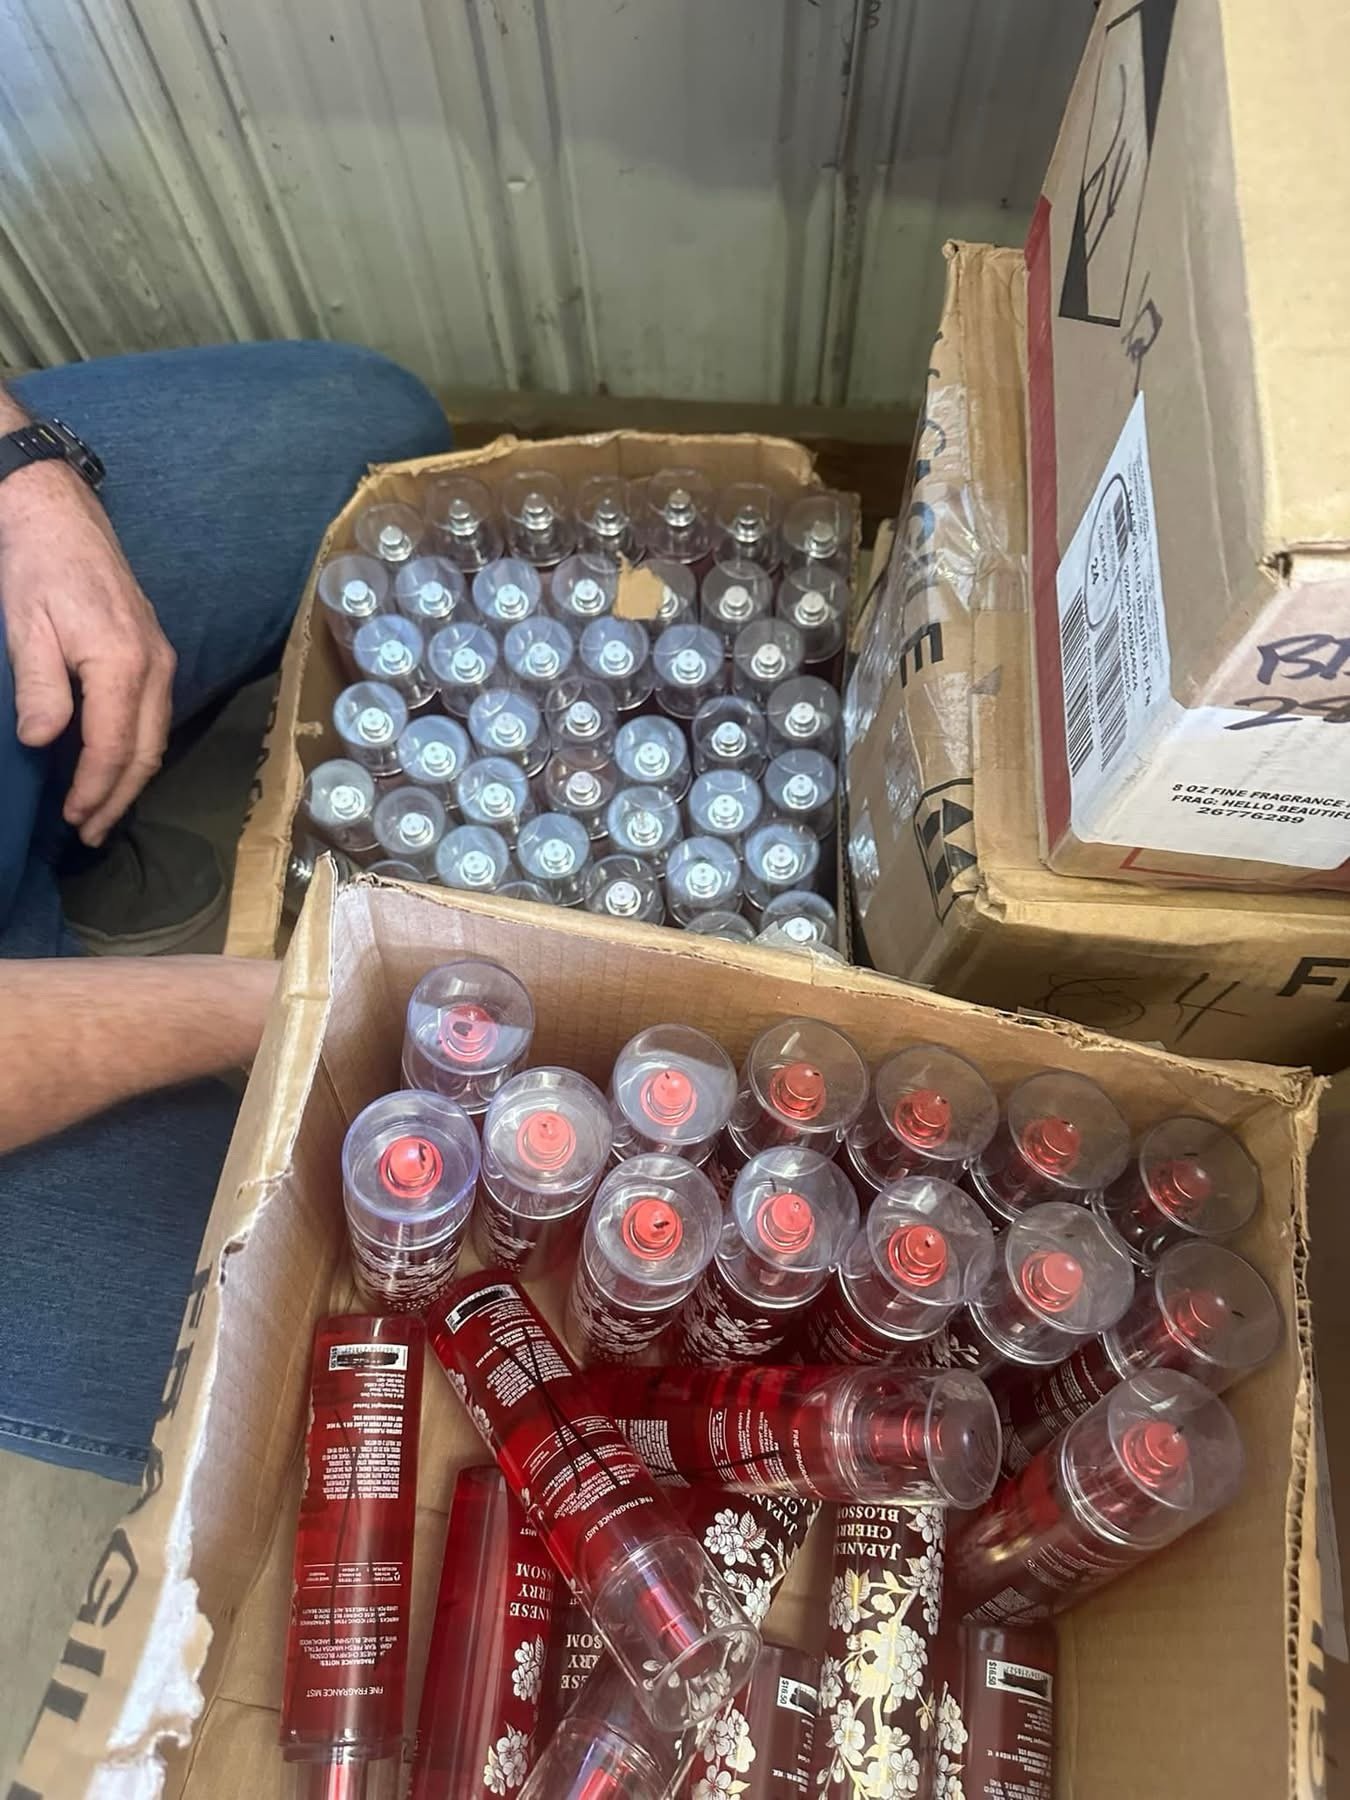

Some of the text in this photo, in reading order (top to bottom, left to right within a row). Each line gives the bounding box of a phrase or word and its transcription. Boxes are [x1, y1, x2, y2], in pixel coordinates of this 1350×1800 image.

[1171, 795, 1218, 806] FRAG:
[1222, 799, 1274, 812] HELLO
[1172, 783, 1345, 808] 8 OZ FINE FRAGRANCE
[1196, 807, 1305, 824] 26776289
[1276, 956, 1350, 1002] F
[597, 1499, 639, 1529] FRAGRANCE
[750, 1493, 799, 1535] JAPAN
[520, 1527, 537, 1537] MIST
[583, 1525, 600, 1542] MIST
[306, 1686, 383, 1697] FINE FRAGRANCE MIST
